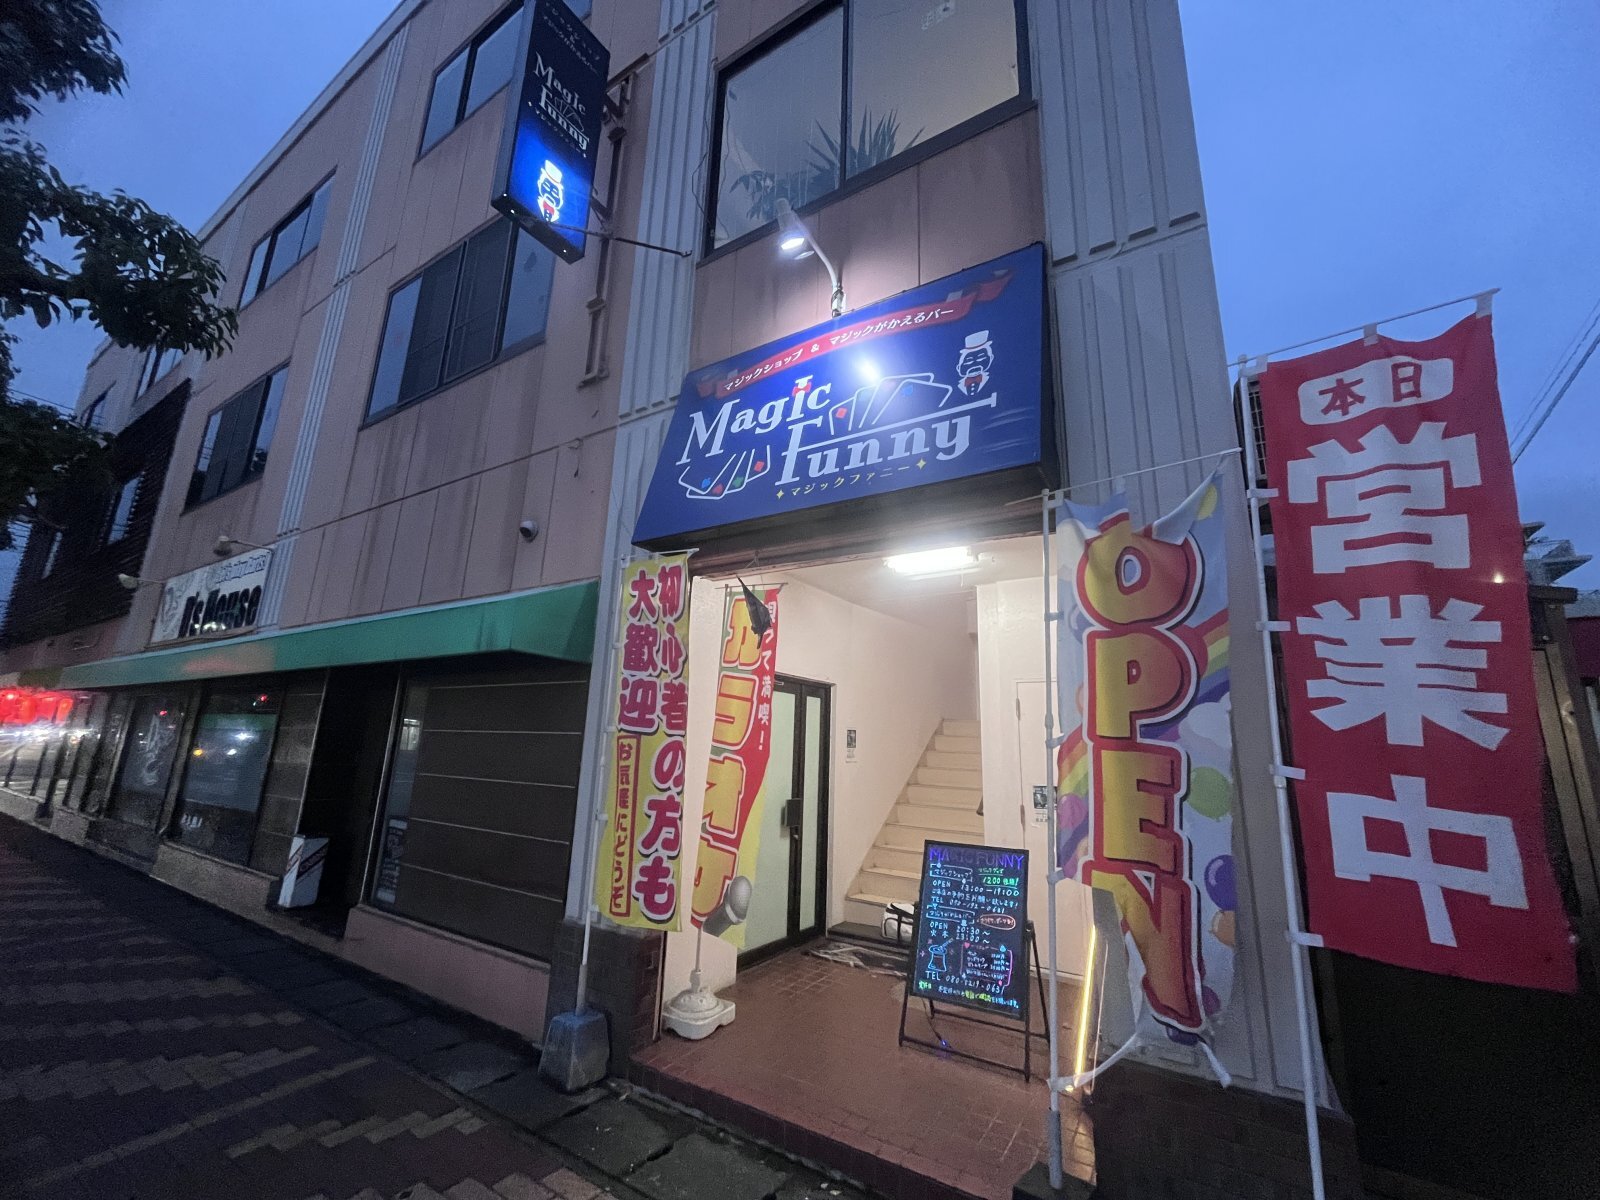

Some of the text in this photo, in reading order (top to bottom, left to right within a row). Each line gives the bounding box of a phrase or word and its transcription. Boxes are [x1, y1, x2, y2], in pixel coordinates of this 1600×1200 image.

[533, 51, 587, 115] Magic
[538, 85, 590, 150] Funny
[724, 308, 954, 391] マジックショップ & マジックがかえるバー
[675, 374, 832, 466] Magic
[1318, 360, 1423, 418] 本日
[774, 393, 997, 486] Funny
[791, 466, 910, 496] マジックファニー
[618, 570, 659, 729] 大歓迎
[1286, 420, 1530, 948] 営業中
[632, 565, 689, 917] 初心者の方も
[1078, 512, 1204, 1026] OPEN
[932, 880, 951, 888] OPEN
[976, 852, 1025, 870] FUNNY
[929, 921, 949, 930] OPEN
[925, 971, 941, 981] TEL
